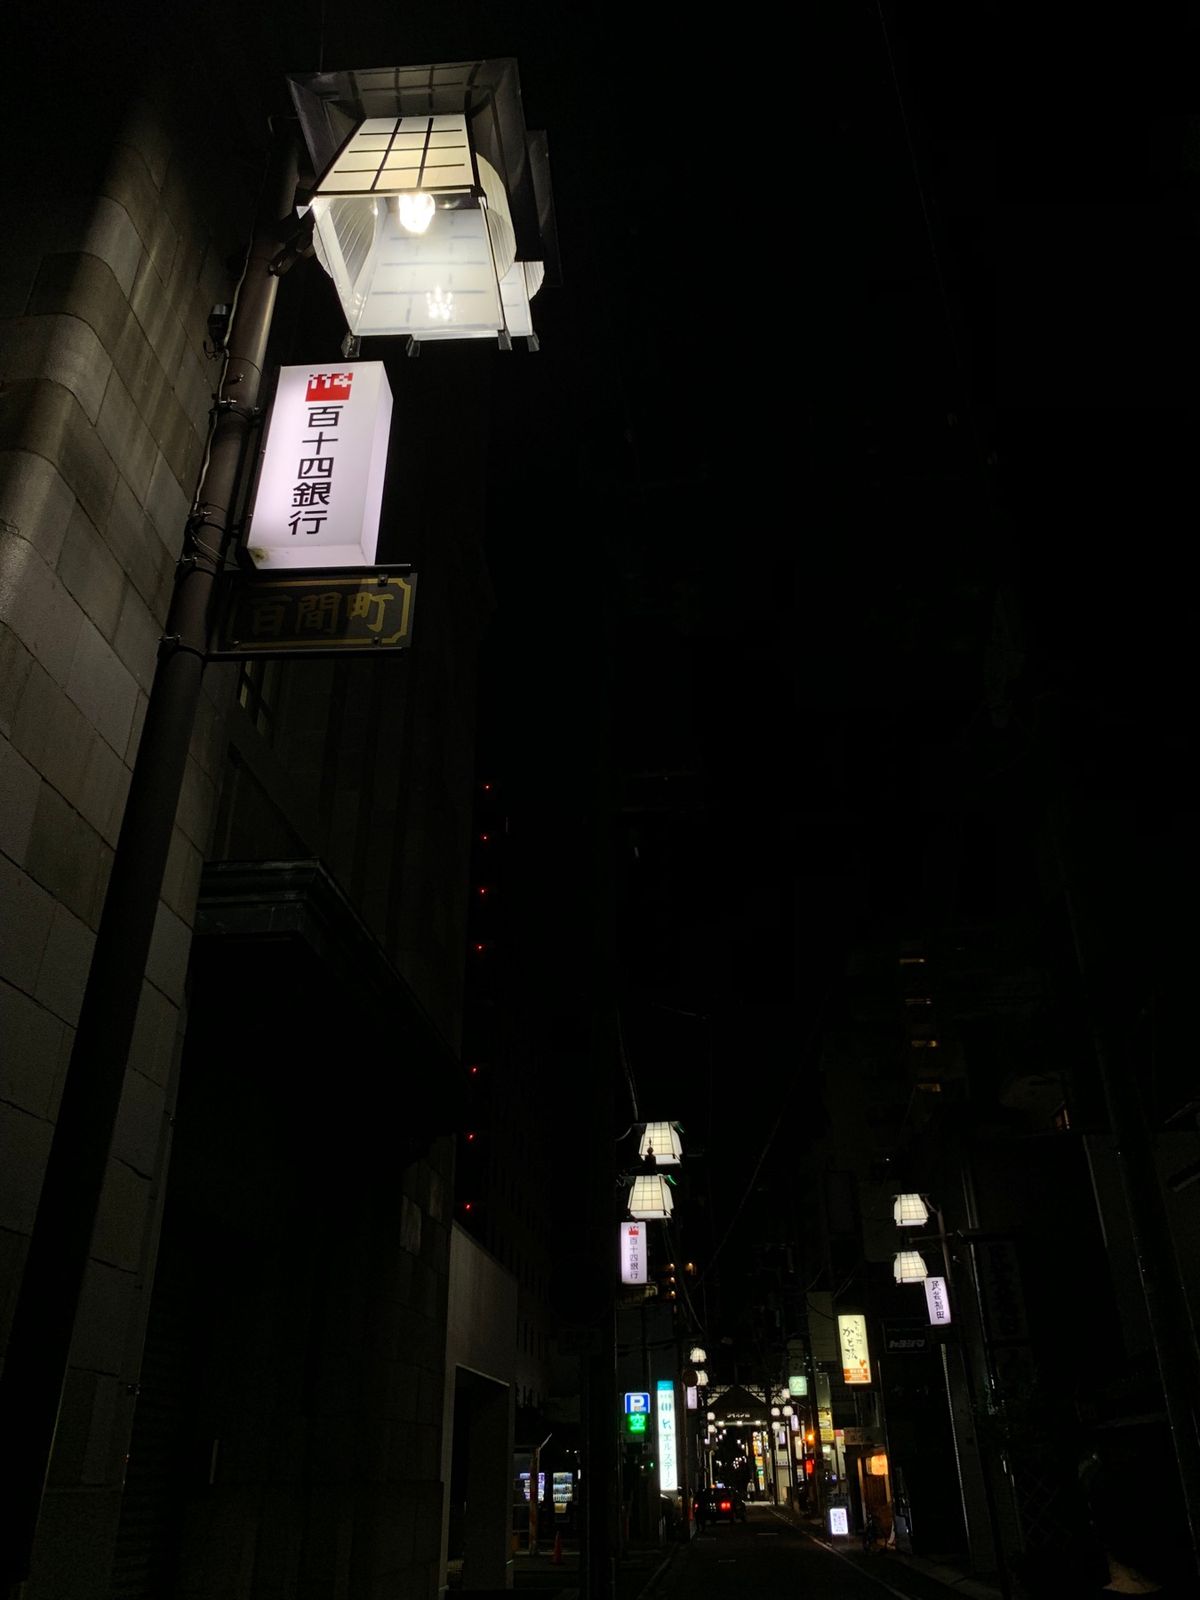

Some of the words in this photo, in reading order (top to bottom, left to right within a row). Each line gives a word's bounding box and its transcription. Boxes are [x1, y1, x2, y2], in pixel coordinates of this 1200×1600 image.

[288, 405, 344, 535] 百十四銀行
[250, 591, 394, 636] 百間町
[629, 1237, 640, 1279] 百十四銀行
